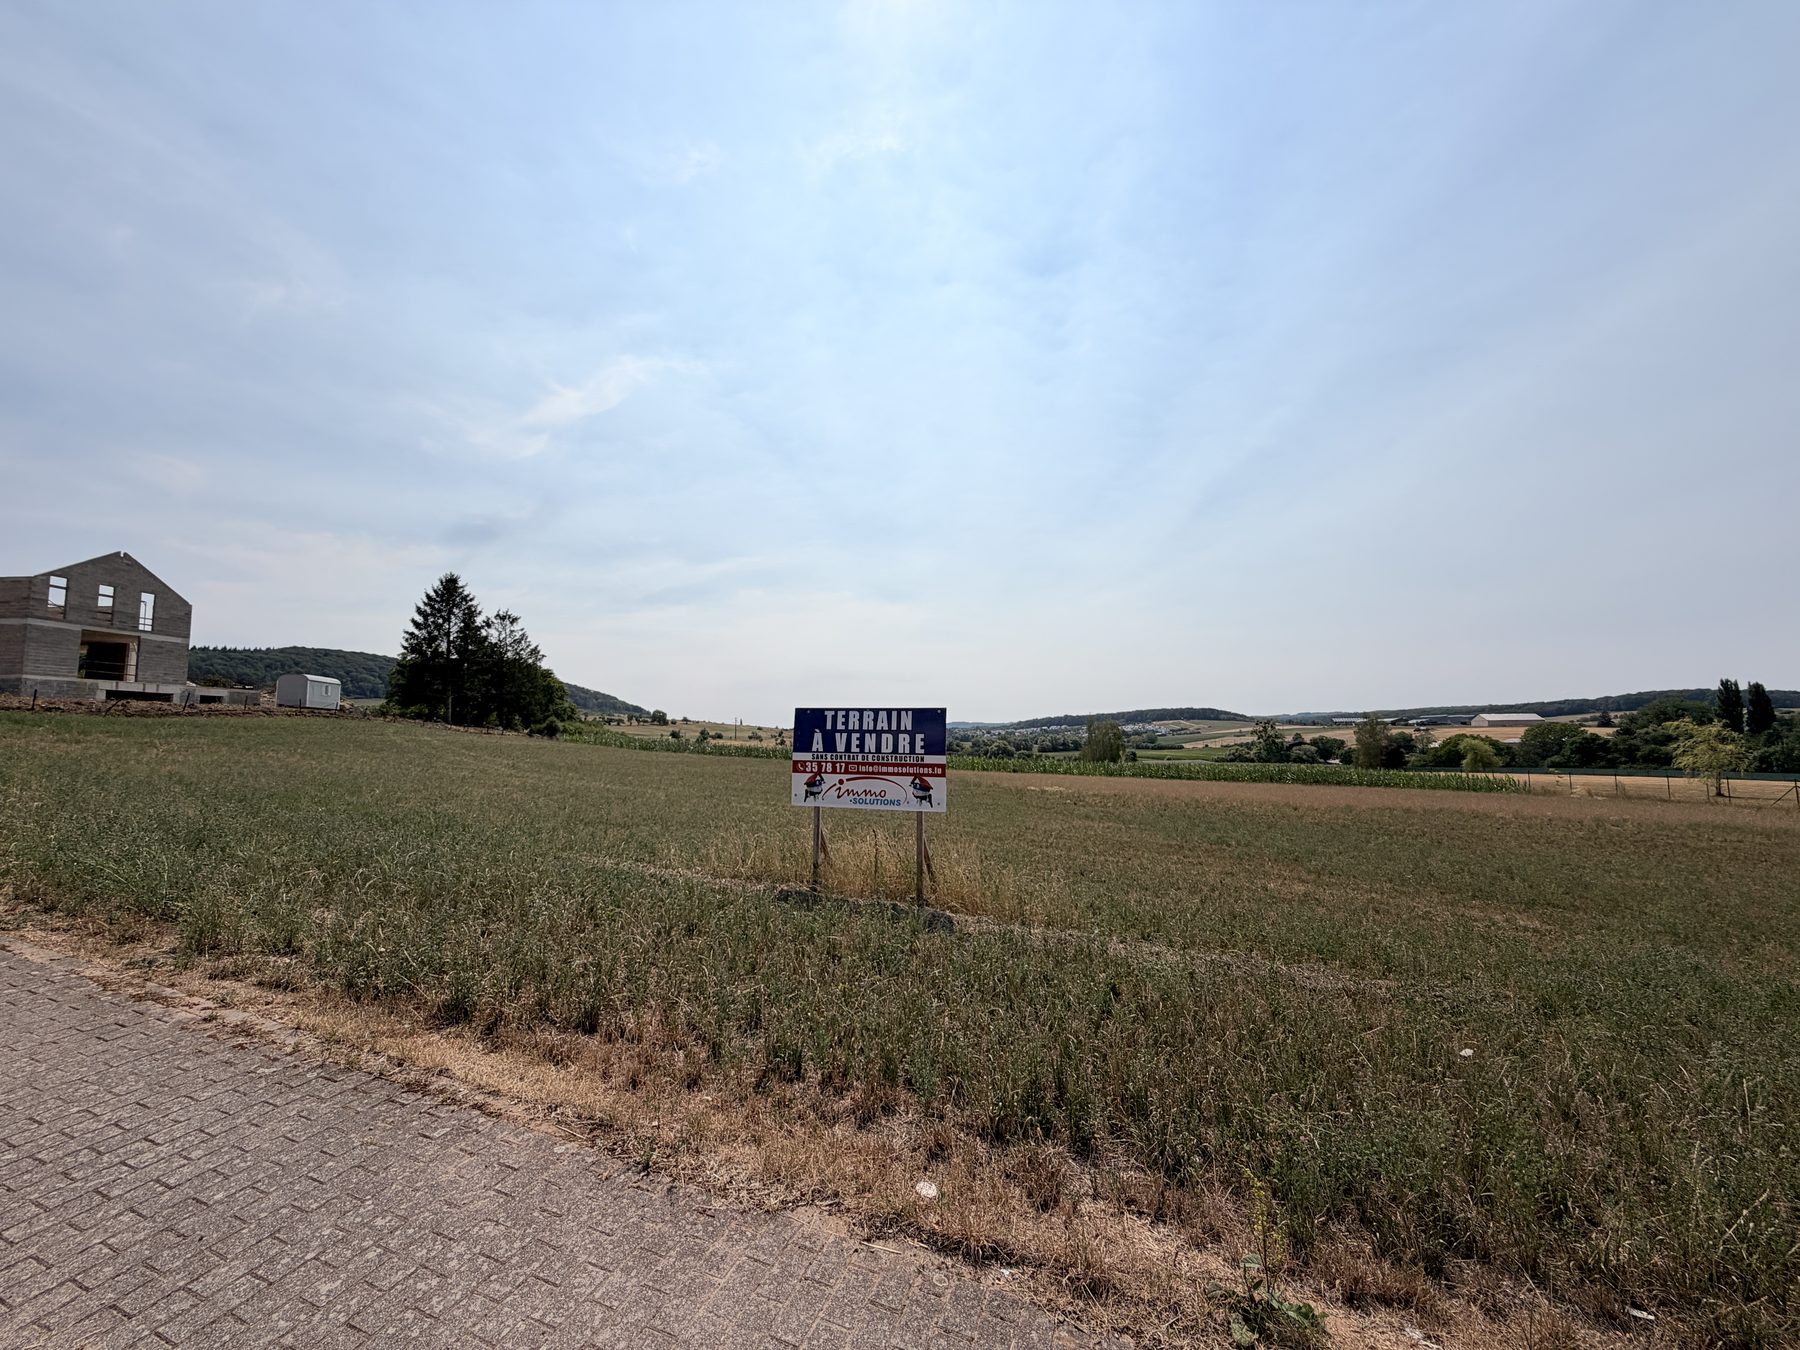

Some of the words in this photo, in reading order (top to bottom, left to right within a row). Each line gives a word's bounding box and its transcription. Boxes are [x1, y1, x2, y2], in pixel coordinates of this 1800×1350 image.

[824, 710, 912, 730] TERRAIN
[812, 729, 823, 752] À
[835, 733, 925, 754] VENDRE
[806, 762, 817, 771] 35
[821, 763, 832, 772] 78
[836, 763, 845, 773] 17
[835, 778, 886, 799] immo
